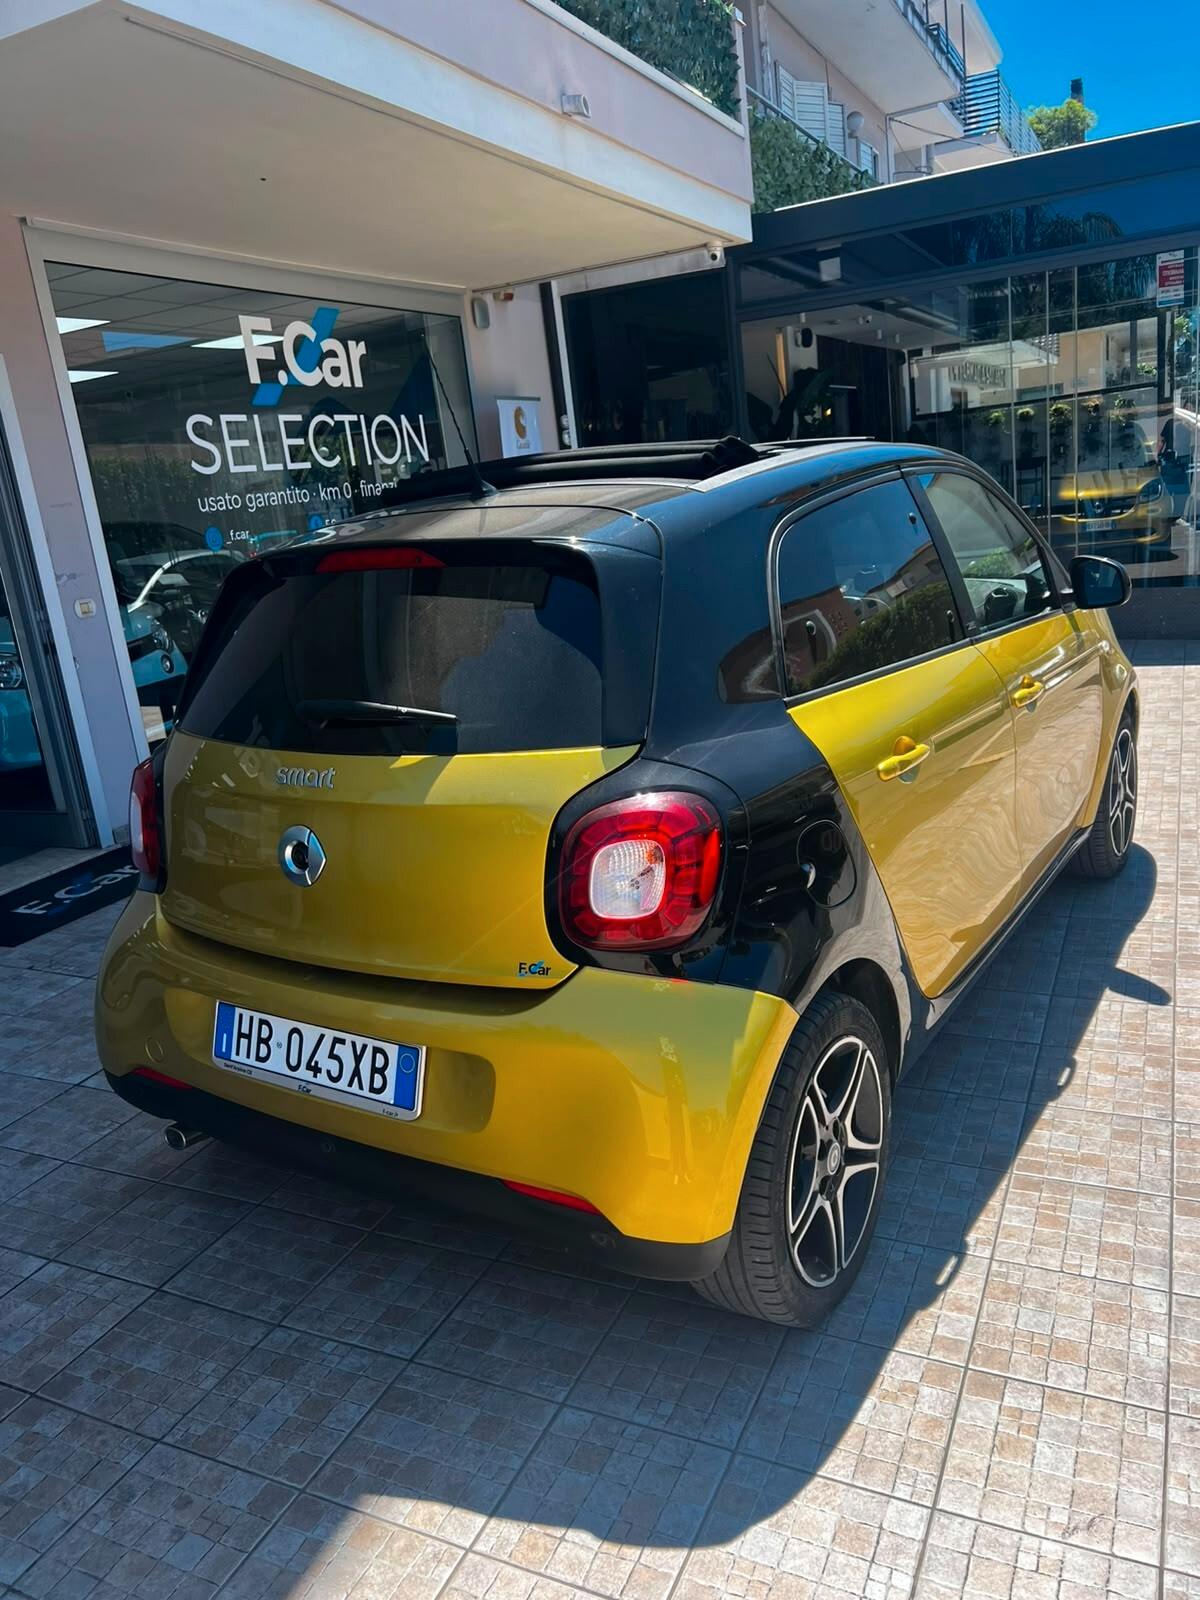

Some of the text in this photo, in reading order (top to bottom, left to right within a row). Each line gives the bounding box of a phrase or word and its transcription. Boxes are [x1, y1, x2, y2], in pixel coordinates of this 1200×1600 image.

[238, 314, 367, 388] F.Car
[185, 413, 430, 475] SELECTION
[197, 493, 242, 513] usato
[246, 484, 310, 512] garantito
[318, 483, 341, 501] km
[343, 482, 352, 499] 0
[276, 767, 336, 789] smart
[518, 961, 552, 976] F.Car
[234, 1012, 274, 1064] HB
[285, 1027, 390, 1096] 045XB
